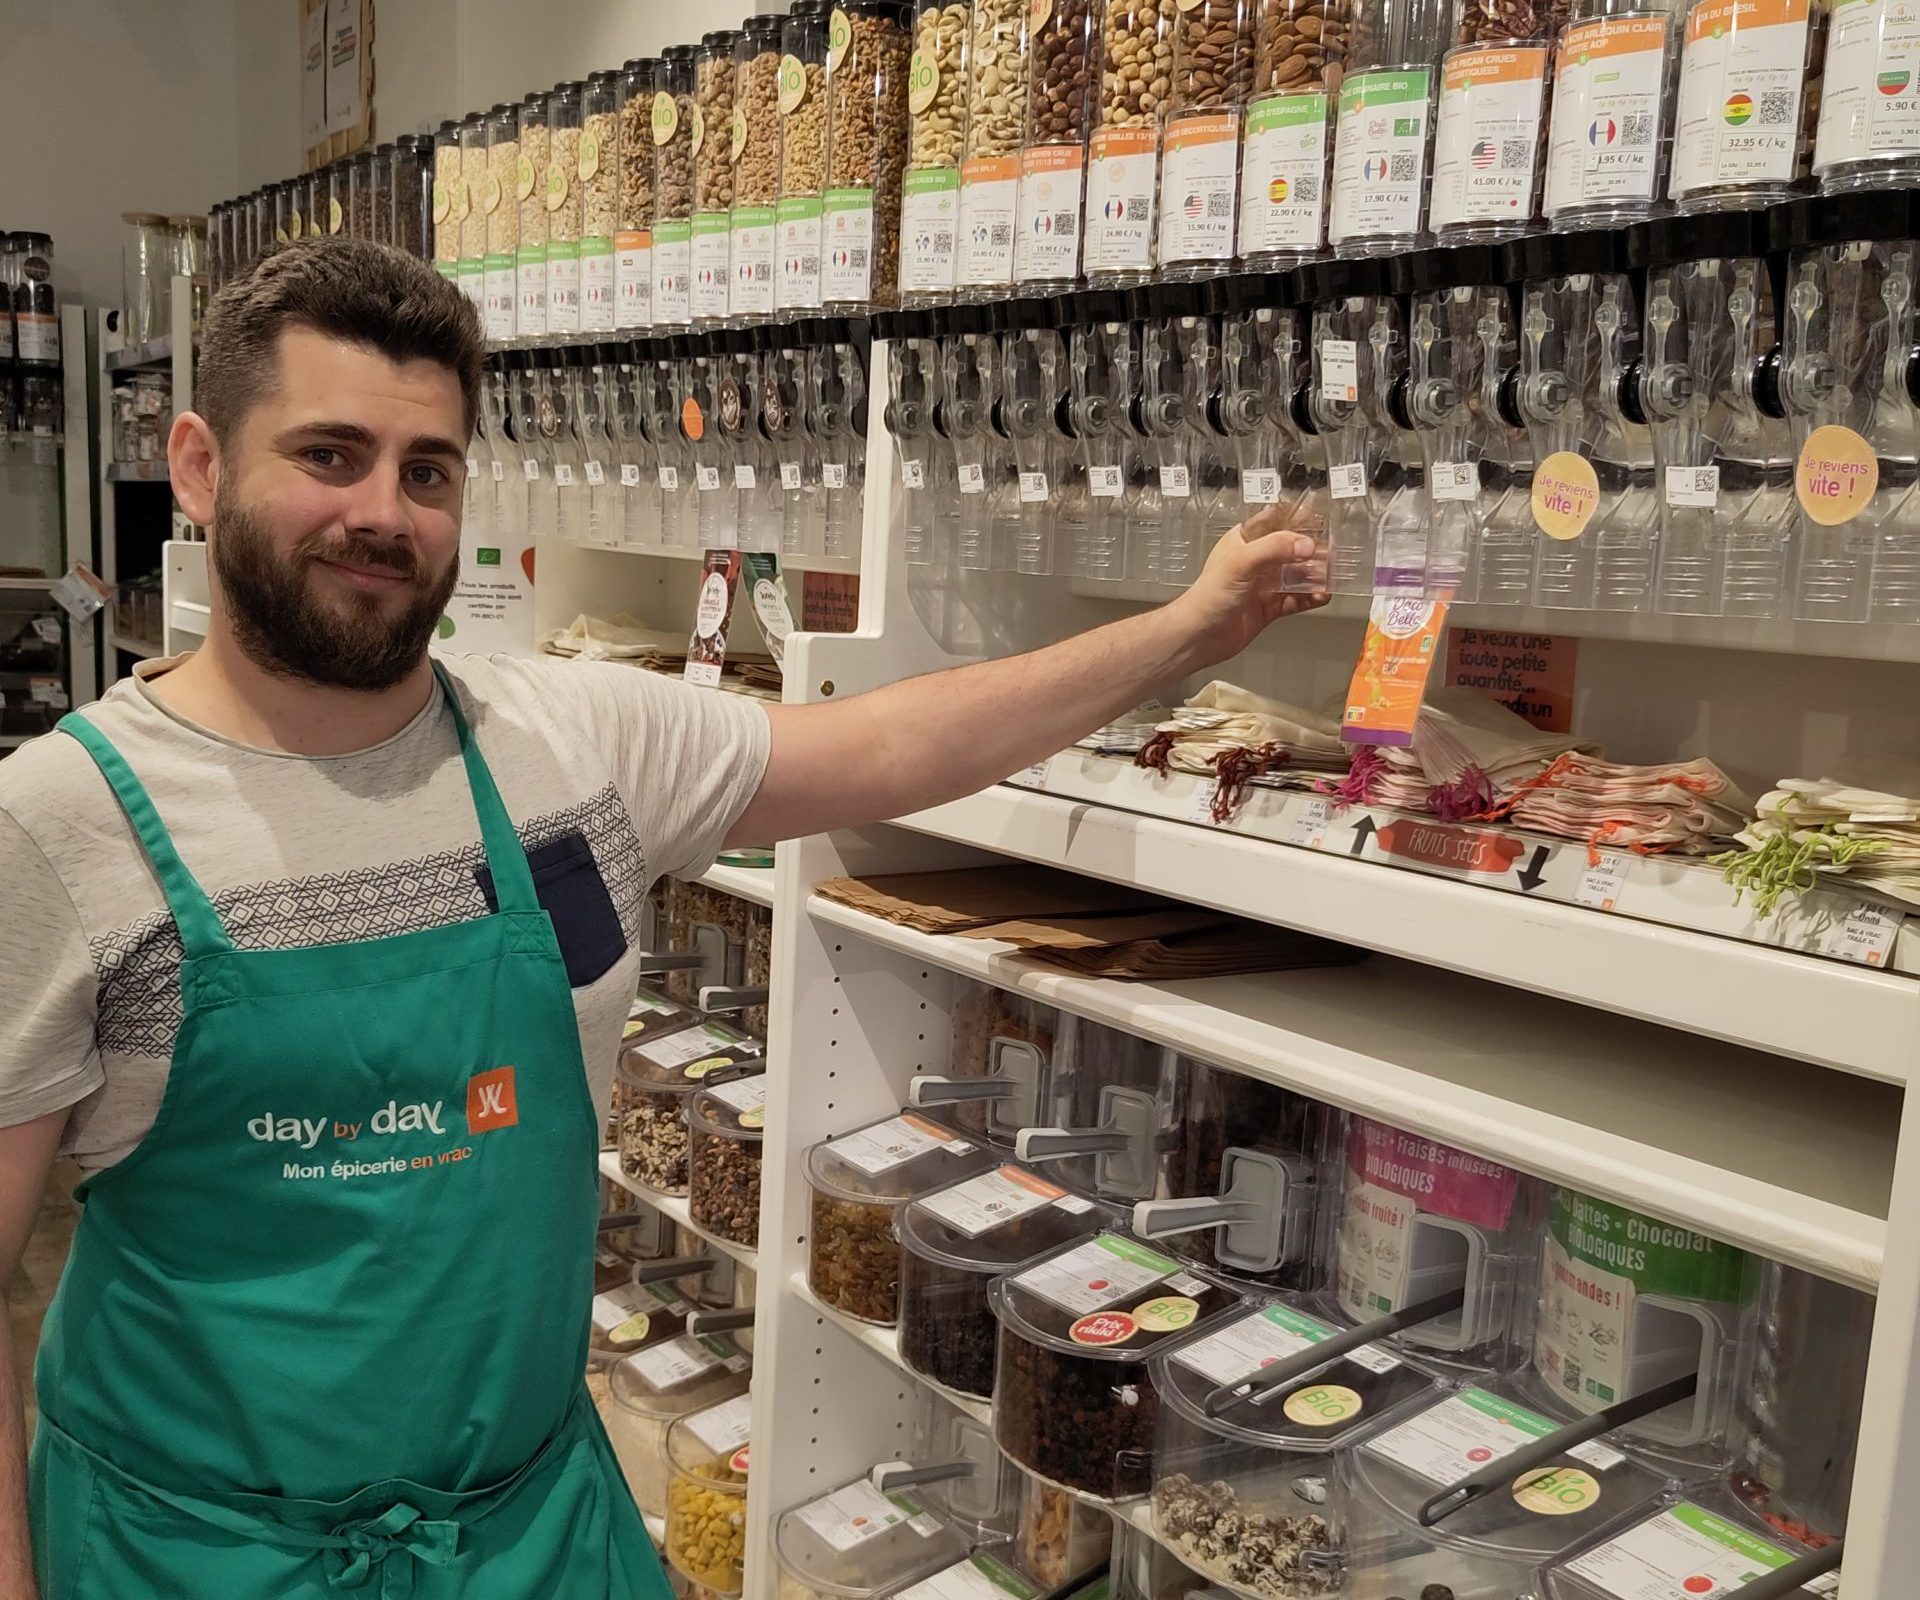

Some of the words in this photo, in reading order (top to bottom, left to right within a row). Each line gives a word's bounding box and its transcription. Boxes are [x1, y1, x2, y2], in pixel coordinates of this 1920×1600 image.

[1631, 22, 1662, 33] CLAIR
[1485, 54, 1517, 65] CRUES
[1392, 81, 1408, 91] BIO
[1885, 101, 1909, 112] 5.90
[1728, 136, 1755, 147] 32.95
[1757, 136, 1765, 147] €
[1774, 137, 1787, 149] kg
[1632, 153, 1645, 165] kg
[1473, 178, 1496, 186] 41.00
[1512, 176, 1522, 187] kg
[1364, 195, 1385, 203] 17.90
[1399, 194, 1409, 203] kg
[1270, 209, 1290, 217] 22.90
[1303, 209, 1313, 217] kg
[1804, 455, 1816, 470] Je
[1818, 460, 1869, 475] reviens
[1539, 474, 1553, 488] Je
[1554, 480, 1594, 499] reviens
[1808, 473, 1841, 498] vite
[1848, 477, 1855, 499] !
[1544, 491, 1572, 516] vite
[1576, 499, 1584, 519] !
[1458, 628, 1477, 644] Je
[1479, 632, 1520, 649] veux
[1521, 635, 1552, 651] une
[1458, 648, 1499, 669] toute
[1502, 653, 1548, 676] petite
[1531, 701, 1553, 719] un
[1407, 826, 1447, 859] FRUITS
[1451, 838, 1488, 866] SECS
[246, 1110, 328, 1150] day
[333, 1120, 364, 1142] by
[370, 1099, 448, 1136] day
[1396, 1133, 1446, 1166] Fraises
[282, 1161, 326, 1180] Mon
[330, 1155, 408, 1182] épicerie
[410, 1155, 434, 1170] en
[437, 1144, 474, 1166] vrac
[1365, 1153, 1436, 1194] BIOLOGIQUES
[1371, 1201, 1399, 1227] fruité
[1571, 1195, 1611, 1231] Dattes
[1567, 1222, 1647, 1272] BIOLOGIQUES
[1092, 1316, 1125, 1331] Prix
[1146, 1301, 1190, 1324] BIO
[1301, 1389, 1345, 1419] BIO
[1526, 1473, 1586, 1506] BIO
